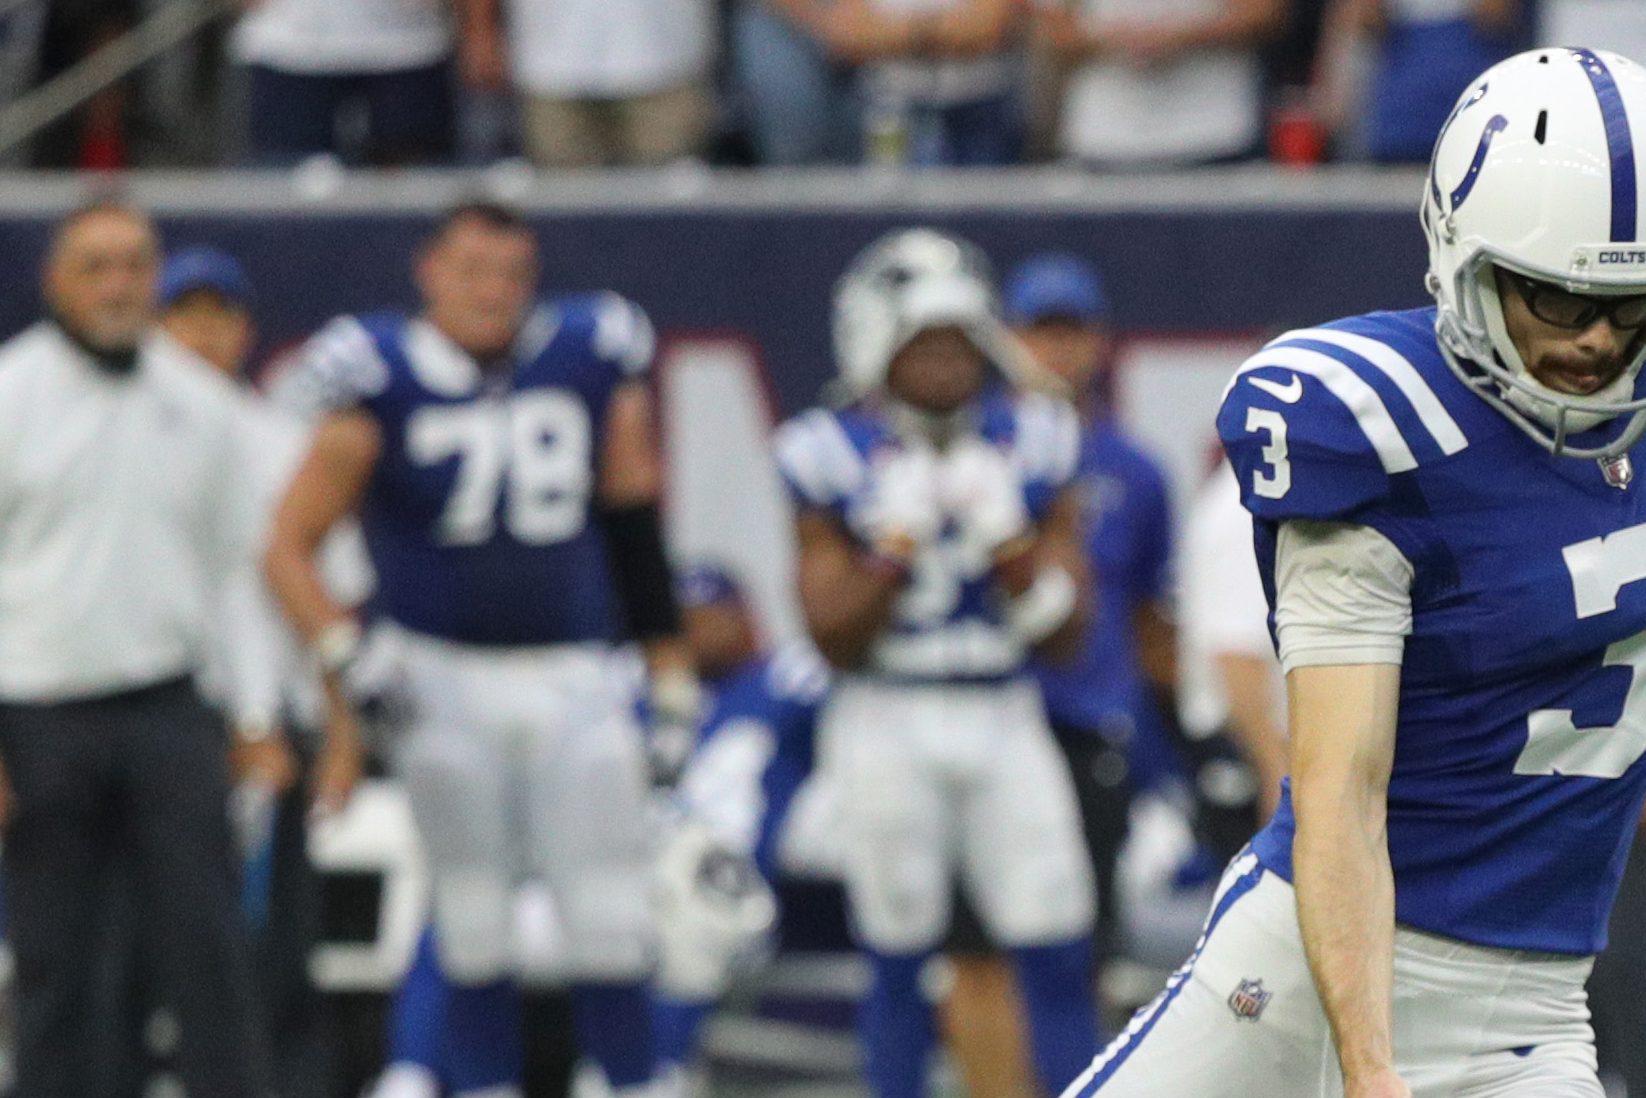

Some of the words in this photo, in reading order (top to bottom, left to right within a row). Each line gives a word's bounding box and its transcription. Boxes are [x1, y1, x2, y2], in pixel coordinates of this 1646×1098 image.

[1598, 251, 1646, 264] COLTS
[404, 387, 593, 548] 78
[1245, 408, 1292, 500] 3
